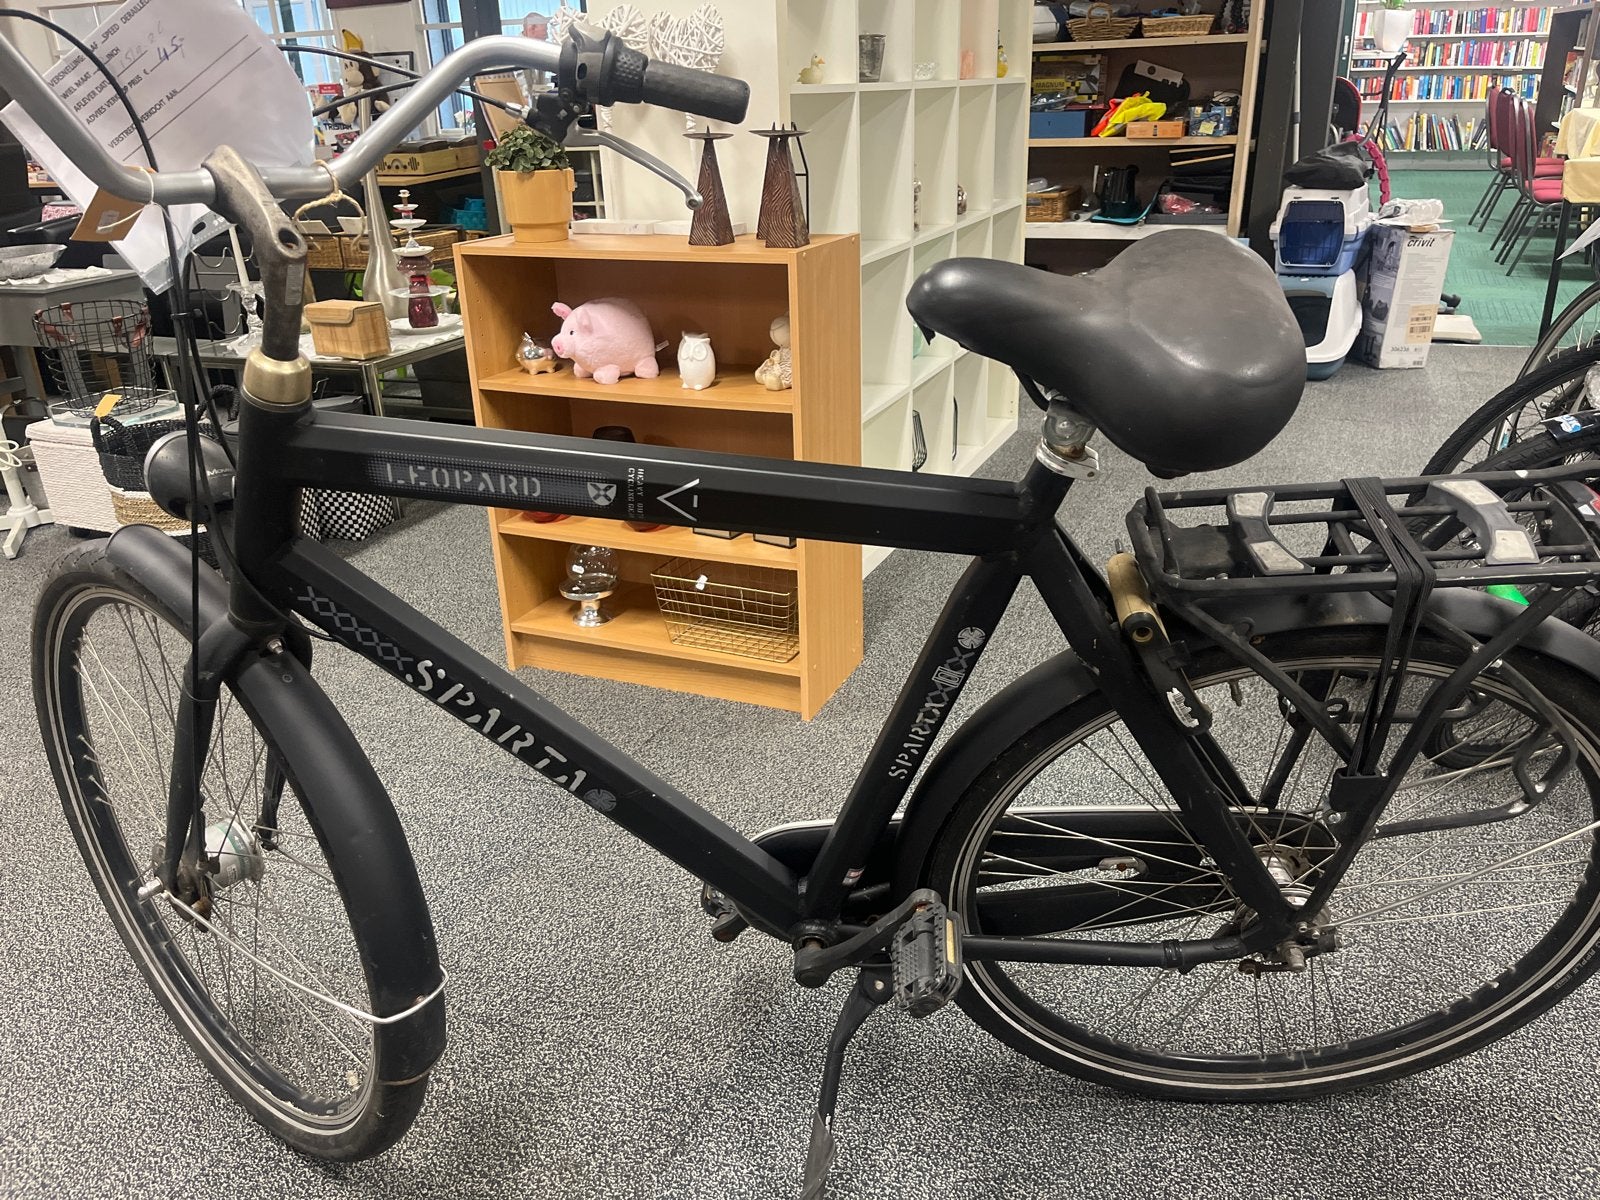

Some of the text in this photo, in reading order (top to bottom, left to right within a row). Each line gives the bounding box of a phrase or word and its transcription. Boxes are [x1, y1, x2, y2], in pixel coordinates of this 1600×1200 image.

[61, 46, 120, 100] WIEL MAAT INCH
[166, 88, 179, 101] AAN
[1035, 81, 1065, 89] MAGNUM
[73, 89, 98, 112] AFLEVER
[85, 105, 107, 124] ADVIES
[1407, 237, 1435, 247] crivit
[386, 461, 542, 498] LEOPARD
[636, 468, 645, 497] HEAVY
[405, 659, 587, 792] SPARTA
